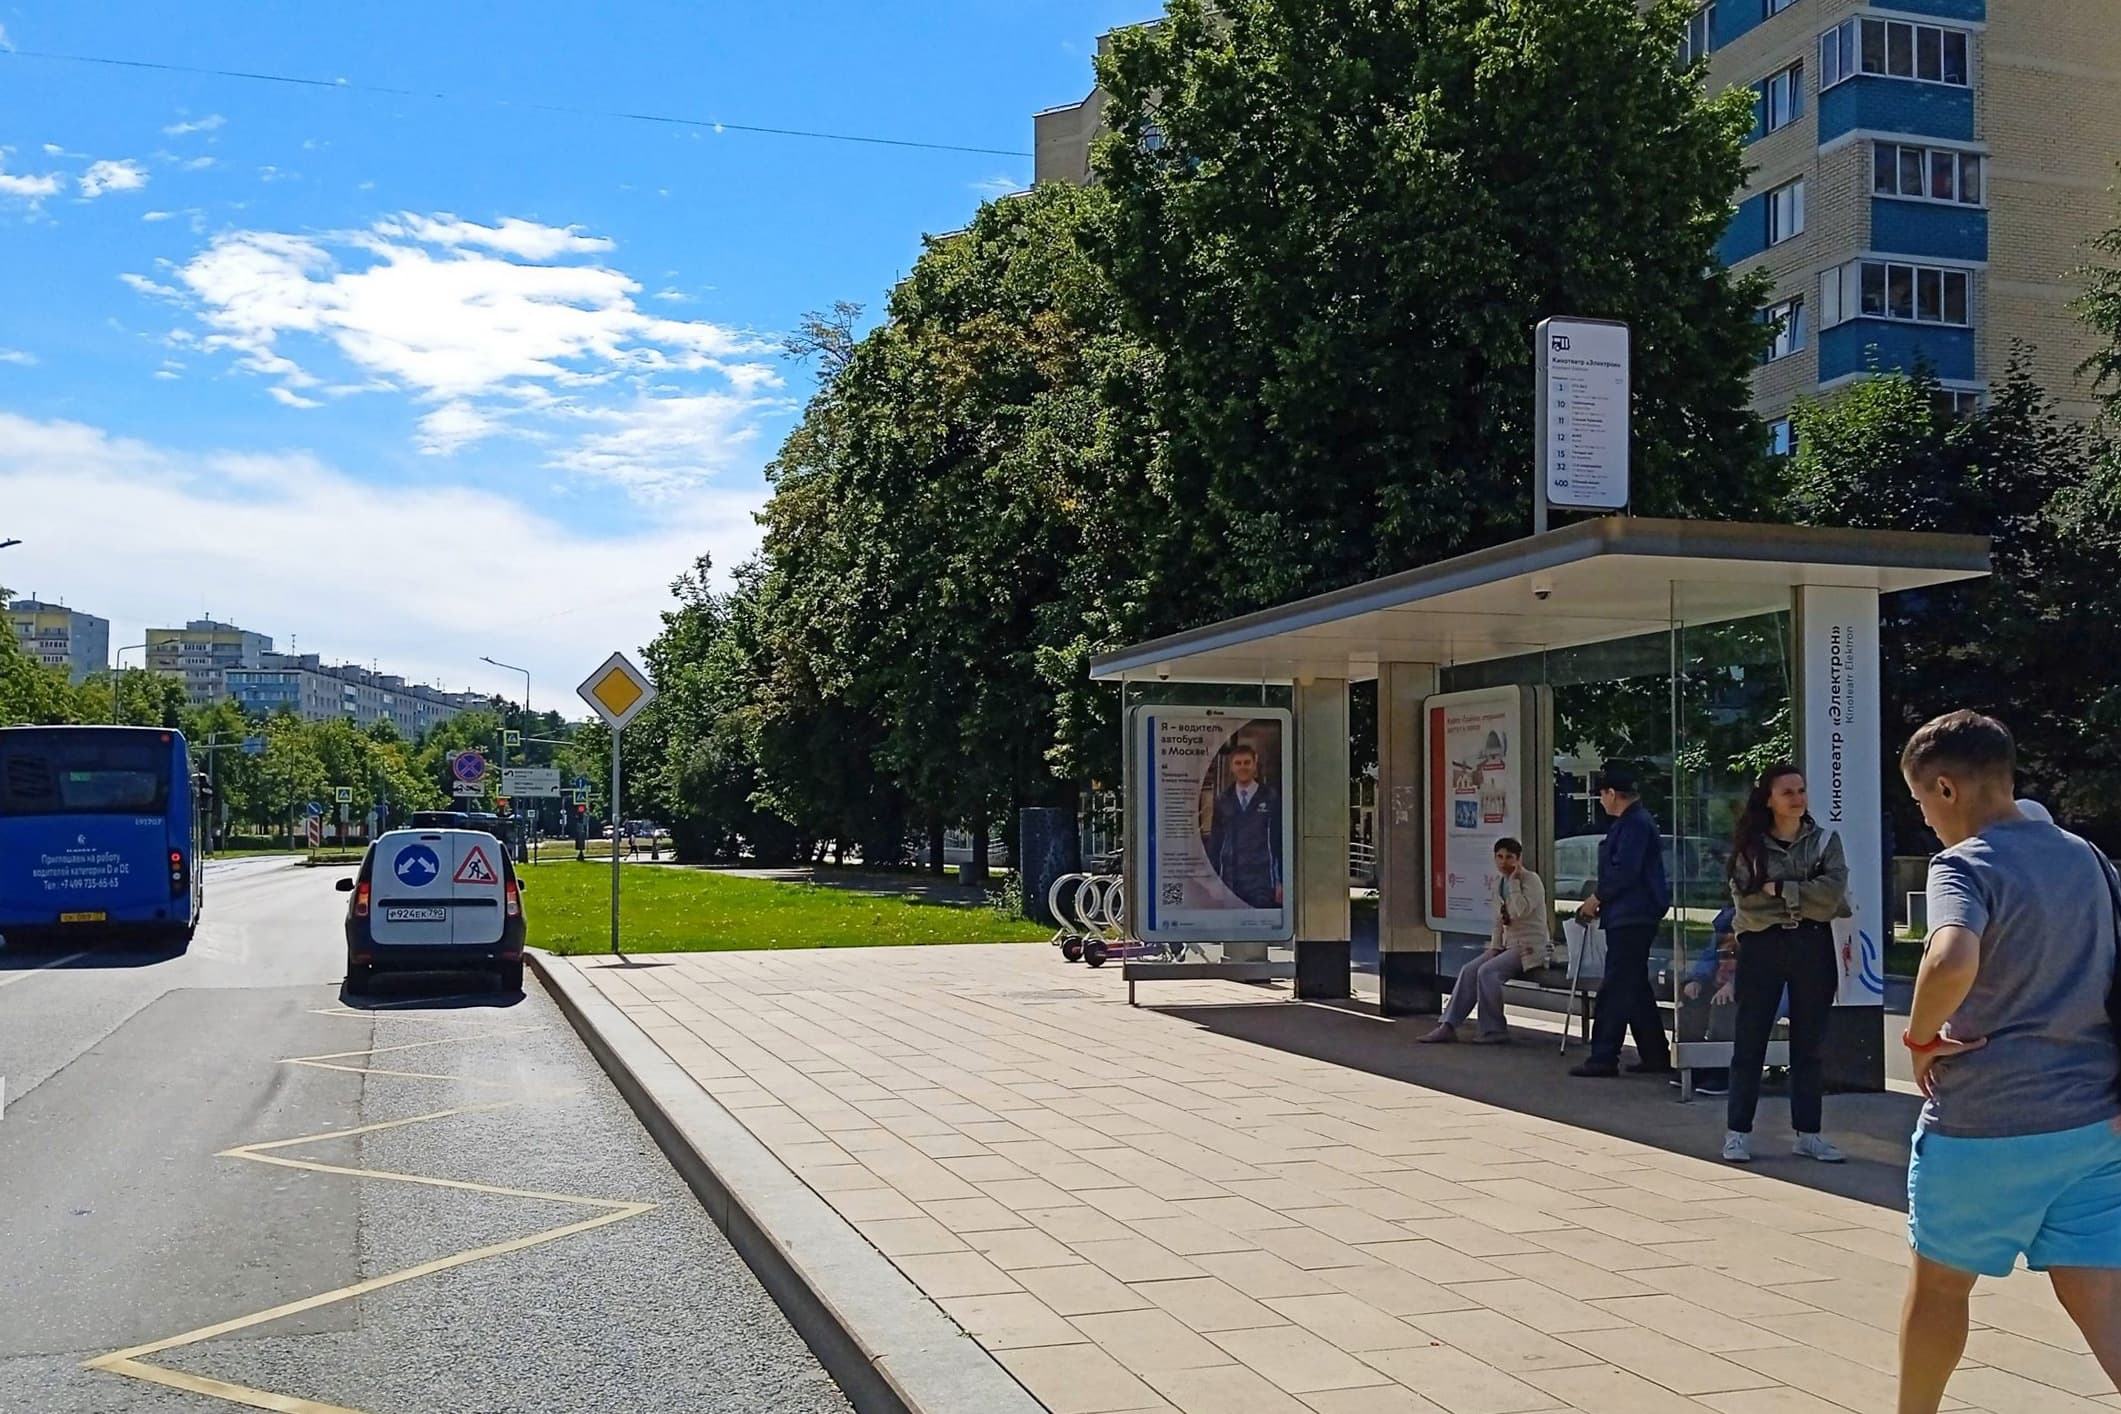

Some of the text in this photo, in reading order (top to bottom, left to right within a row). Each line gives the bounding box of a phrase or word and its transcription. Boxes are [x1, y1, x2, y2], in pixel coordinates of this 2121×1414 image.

[1557, 400, 1566, 408] 10
[1558, 416, 1564, 424] 11
[1557, 433, 1565, 441] 12
[1557, 450, 1565, 458] 15
[1556, 463, 1566, 471] 32
[1554, 479, 1569, 487] 400
[1844, 625, 1854, 724] Kinoteatr Elektron
[1161, 722, 1168, 731] Я
[1178, 724, 1223, 733] водитель
[1828, 625, 1844, 822] Кинотеатр «Электрон»
[1161, 735, 1203, 745] автобуса
[1161, 746, 1209, 756] в Москве!
[106, 864, 113, 874] D
[119, 863, 129, 874] DE
[60, 879, 68, 888] +7
[69, 878, 83, 889] 499
